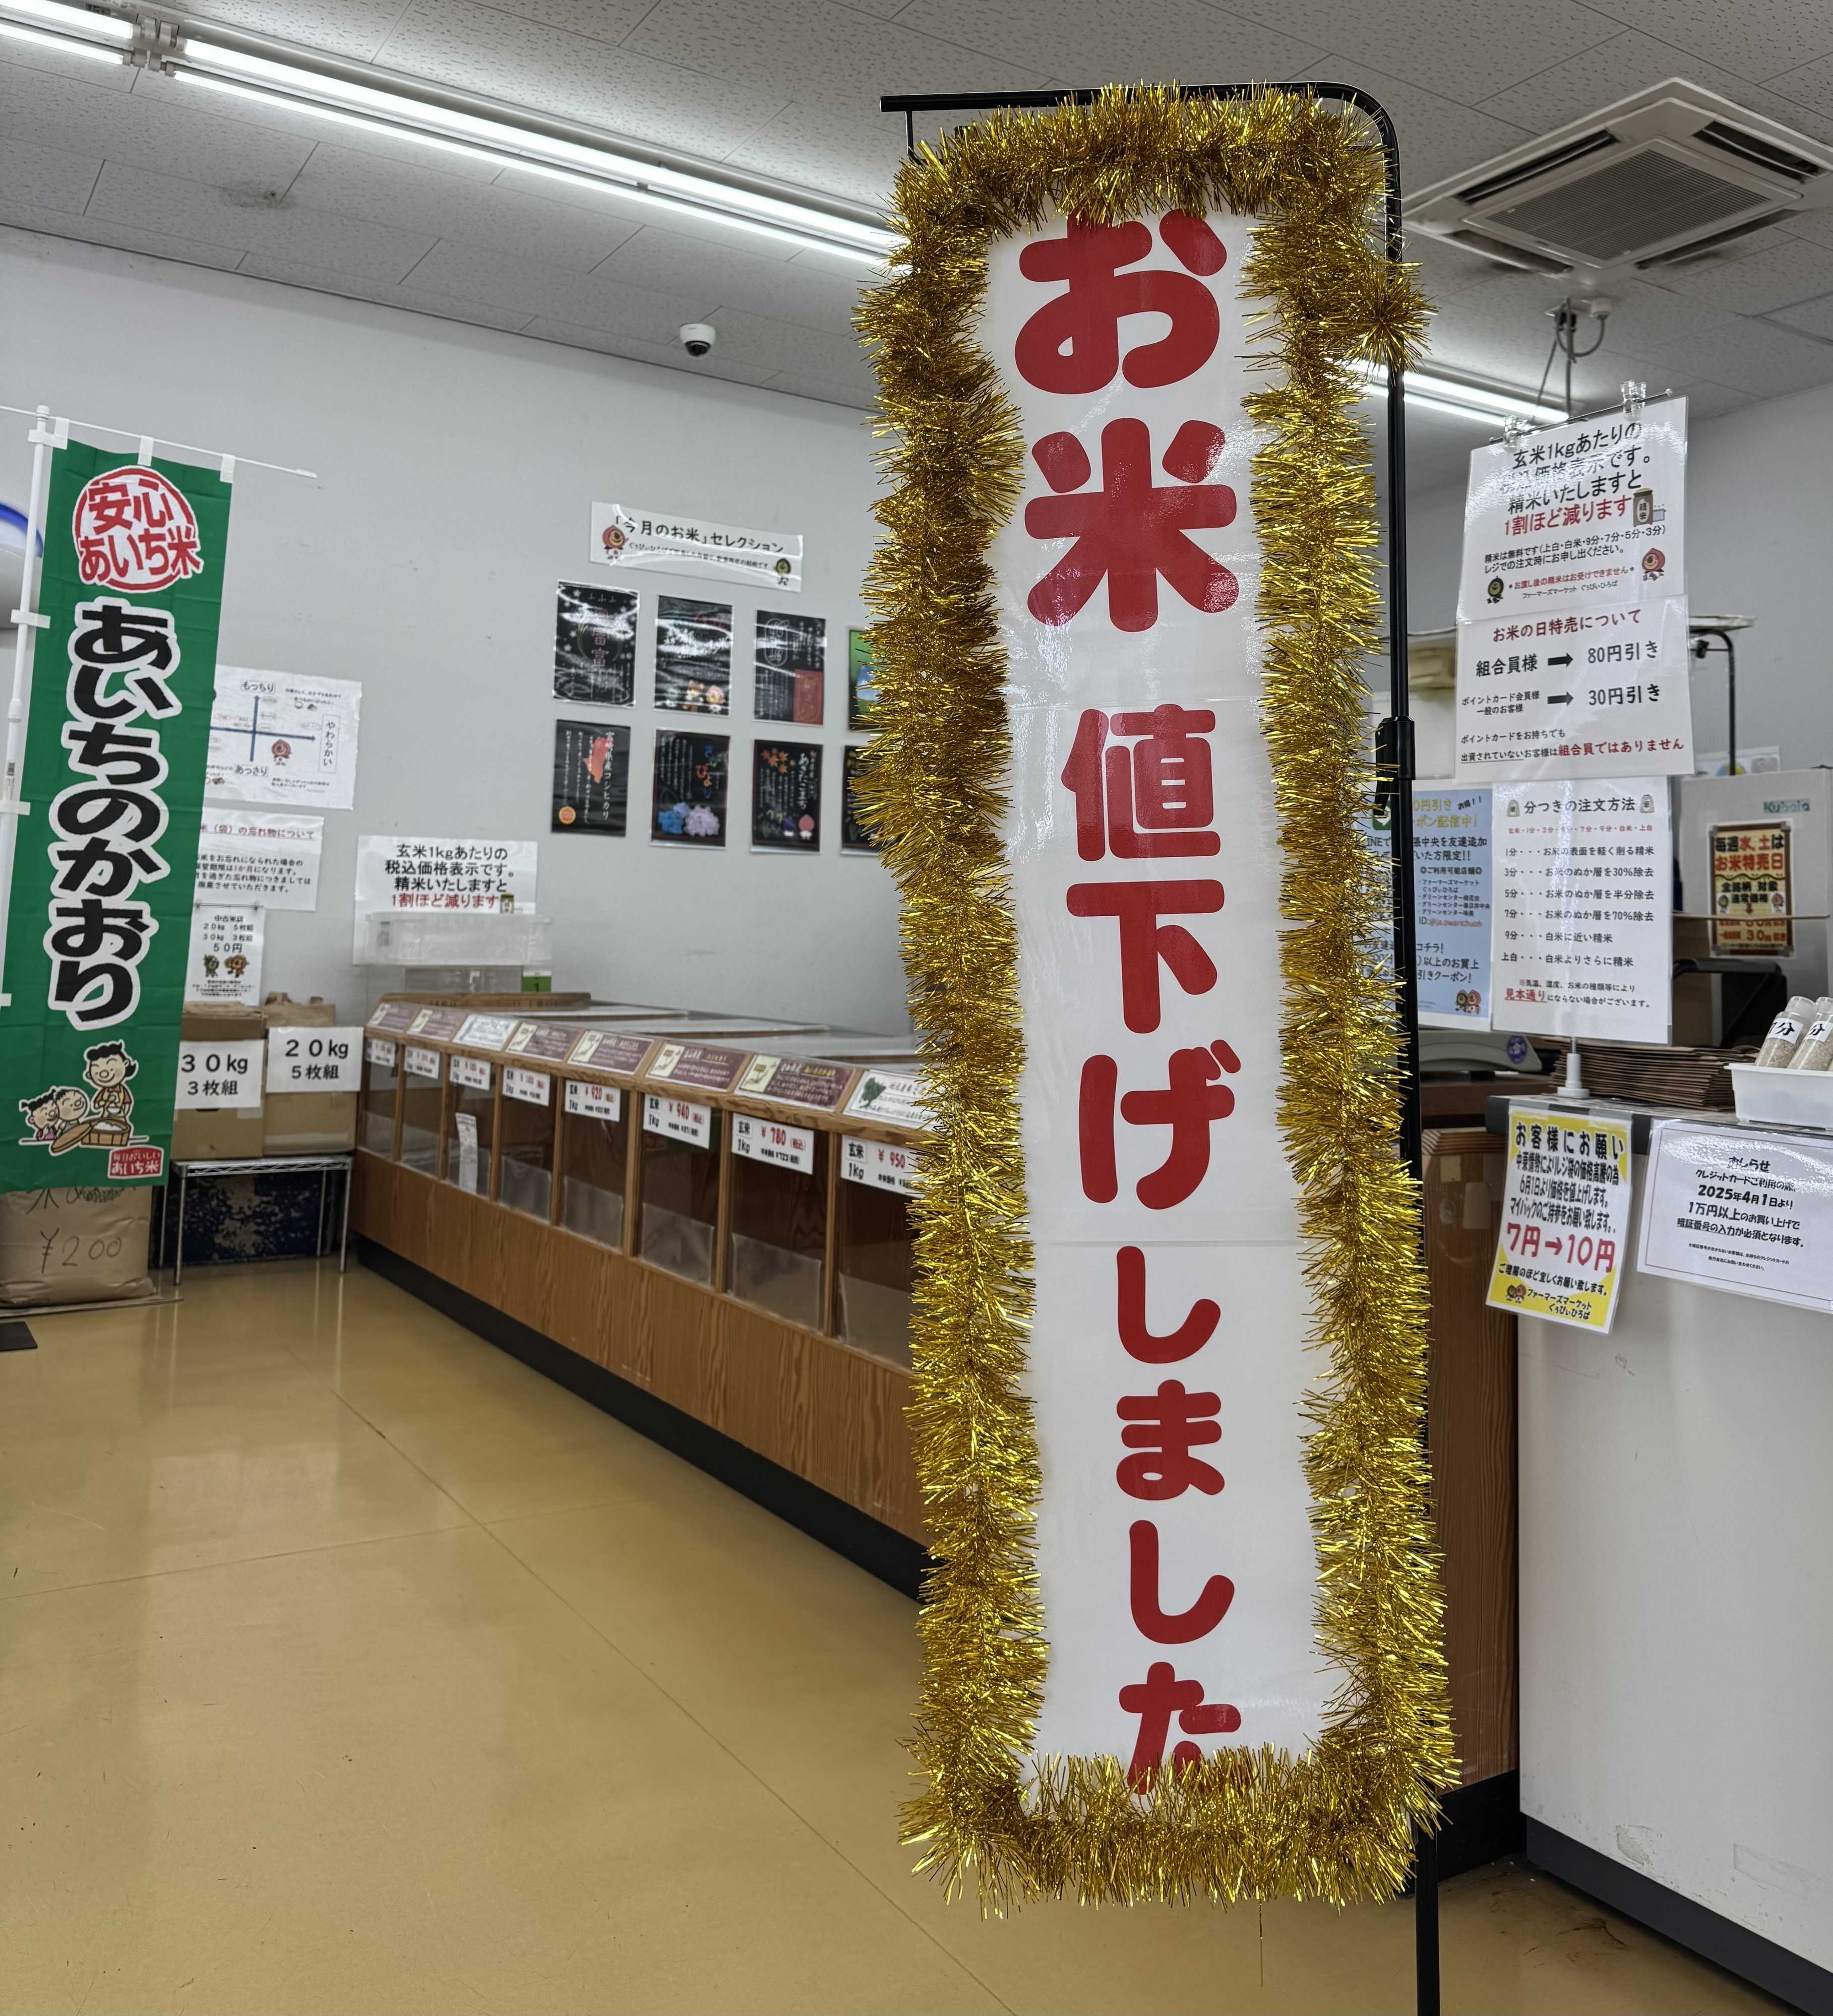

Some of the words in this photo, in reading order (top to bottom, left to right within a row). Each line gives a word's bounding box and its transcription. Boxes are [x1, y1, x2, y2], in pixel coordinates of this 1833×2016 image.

[1512, 422, 1642, 470] 玄米1kgあたりの
[1508, 469, 1641, 515] 精米いたしますと
[88, 478, 173, 534] 安心
[1504, 494, 1632, 536] 1割ほど減ります
[616, 515, 784, 553] 「今月のお米」セレクション
[79, 526, 201, 582] あいち米
[1484, 544, 1624, 574] レジでの注文時にお申し出ください。
[1493, 609, 1642, 643] お米の日特売について
[1476, 653, 1538, 677] 組合員様
[1587, 640, 1658, 664] 80円引き
[243, 680, 275, 693] もっちり
[1461, 690, 1540, 706] ポイントカード会員様
[1588, 683, 1661, 706] 30円引き
[1477, 703, 1523, 715] 一般のお客様
[323, 721, 335, 766] やわらかい
[1460, 729, 1566, 744] ポイントカードをお持ちでも
[235, 765, 268, 776] あっさり
[49, 605, 173, 1023] あいちのかおり
[1524, 797, 1635, 814] 分つきの注文方法
[197, 854, 303, 866] 米をお忘れになられた場合の
[396, 843, 508, 860] 玄米1kgあたりの
[1715, 852, 1784, 871] お米特売日
[385, 859, 514, 878] 税込価格表示です。
[394, 876, 508, 893] 精米いたしますと
[391, 893, 500, 908] 1割ほど減ります
[213, 942, 242, 953] 50円
[1014, 209, 1242, 1795] お米値下げしました
[284, 1038, 349, 1059] 20kg
[180, 1053, 249, 1075] 30kg
[291, 1064, 339, 1080] 5枚組
[187, 1080, 238, 1097] 3枚組
[738, 1120, 750, 1135] 玄米
[848, 1142, 864, 1159] 玄米
[1515, 1122, 1624, 1160] お客様にお願い
[111, 1161, 159, 1175] あいち米
[1519, 1174, 1608, 1208] 6月1日より価格を値上げします。
[1697, 1184, 1793, 1210] 2025年4月1日より
[1688, 1201, 1801, 1230] 1万円以上のお買い上げで
[1676, 1217, 1804, 1248] 暗証番号の入力が必須となります。
[1506, 1222, 1541, 1257] 7円
[1567, 1233, 1616, 1274] 10円
[1498, 1263, 1607, 1296] ご理解のほど宜しくお願い致します。
[1527, 1288, 1592, 1310] ファーマーズマーケット
